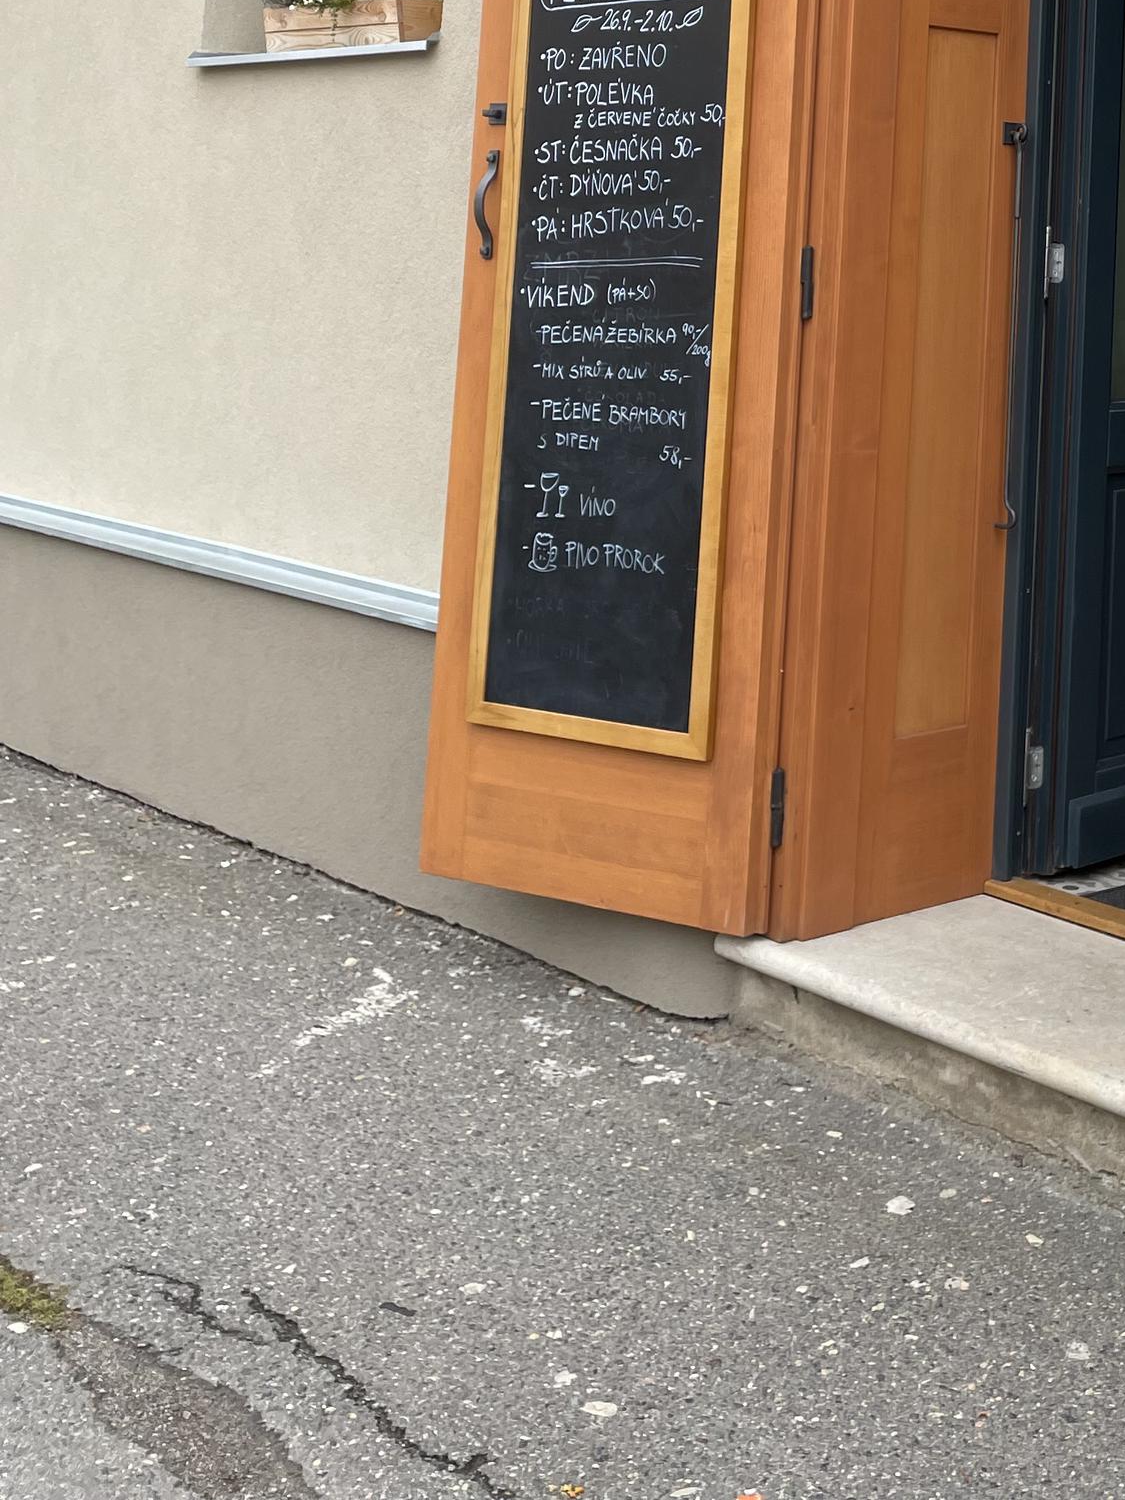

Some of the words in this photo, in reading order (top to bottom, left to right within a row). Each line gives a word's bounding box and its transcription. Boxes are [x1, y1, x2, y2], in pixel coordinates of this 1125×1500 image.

[578, 41, 667, 71] ZAVŘENO
[574, 77, 655, 106] POLÉVKA
[587, 107, 657, 128] ČERVENÉ
[571, 198, 669, 239] HRSTKOVÁ
[527, 277, 595, 308] VÍKEND
[604, 366, 614, 380] A
[617, 365, 648, 380] OLIV
[608, 405, 686, 430] BRAMBORY
[555, 432, 599, 452] DIPEM
[580, 486, 616, 517] VÍNO
[565, 541, 600, 569] PIVO
[603, 543, 665, 575] PROROK
